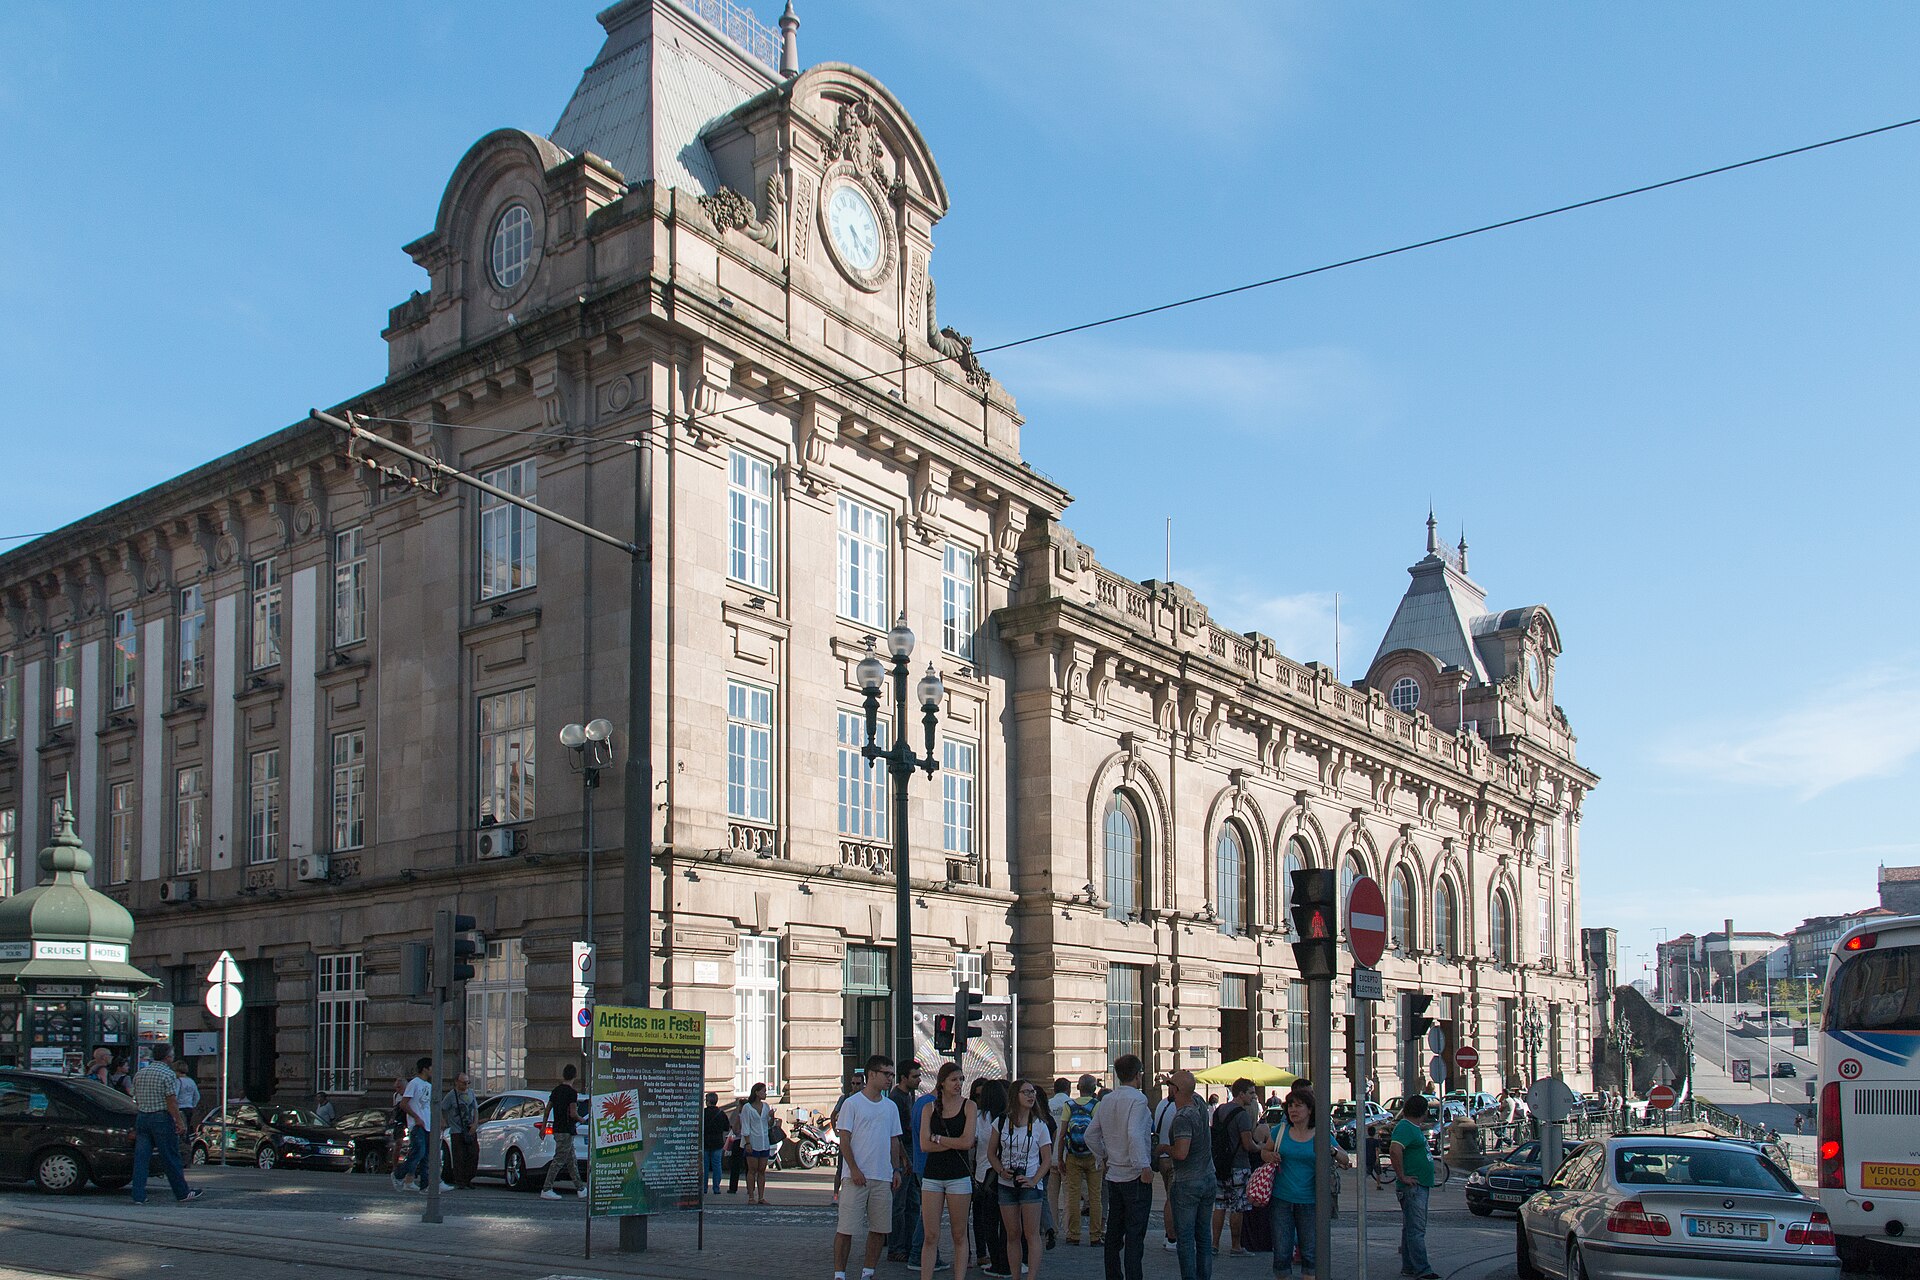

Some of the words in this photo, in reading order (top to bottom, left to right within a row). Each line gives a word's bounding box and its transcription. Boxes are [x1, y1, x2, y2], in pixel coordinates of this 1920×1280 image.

[95, 949, 121, 958] HOTELS
[1360, 975, 1378, 983] EXCEPTO
[600, 1012, 647, 1029] Artistas
[651, 1018, 665, 1030] na
[670, 1016, 700, 1032] Festa
[1844, 1063, 1857, 1074] 80
[596, 1117, 638, 1136] Festa
[1870, 1166, 1920, 1176] VEICULO
[1874, 1177, 1916, 1187] LONGO
